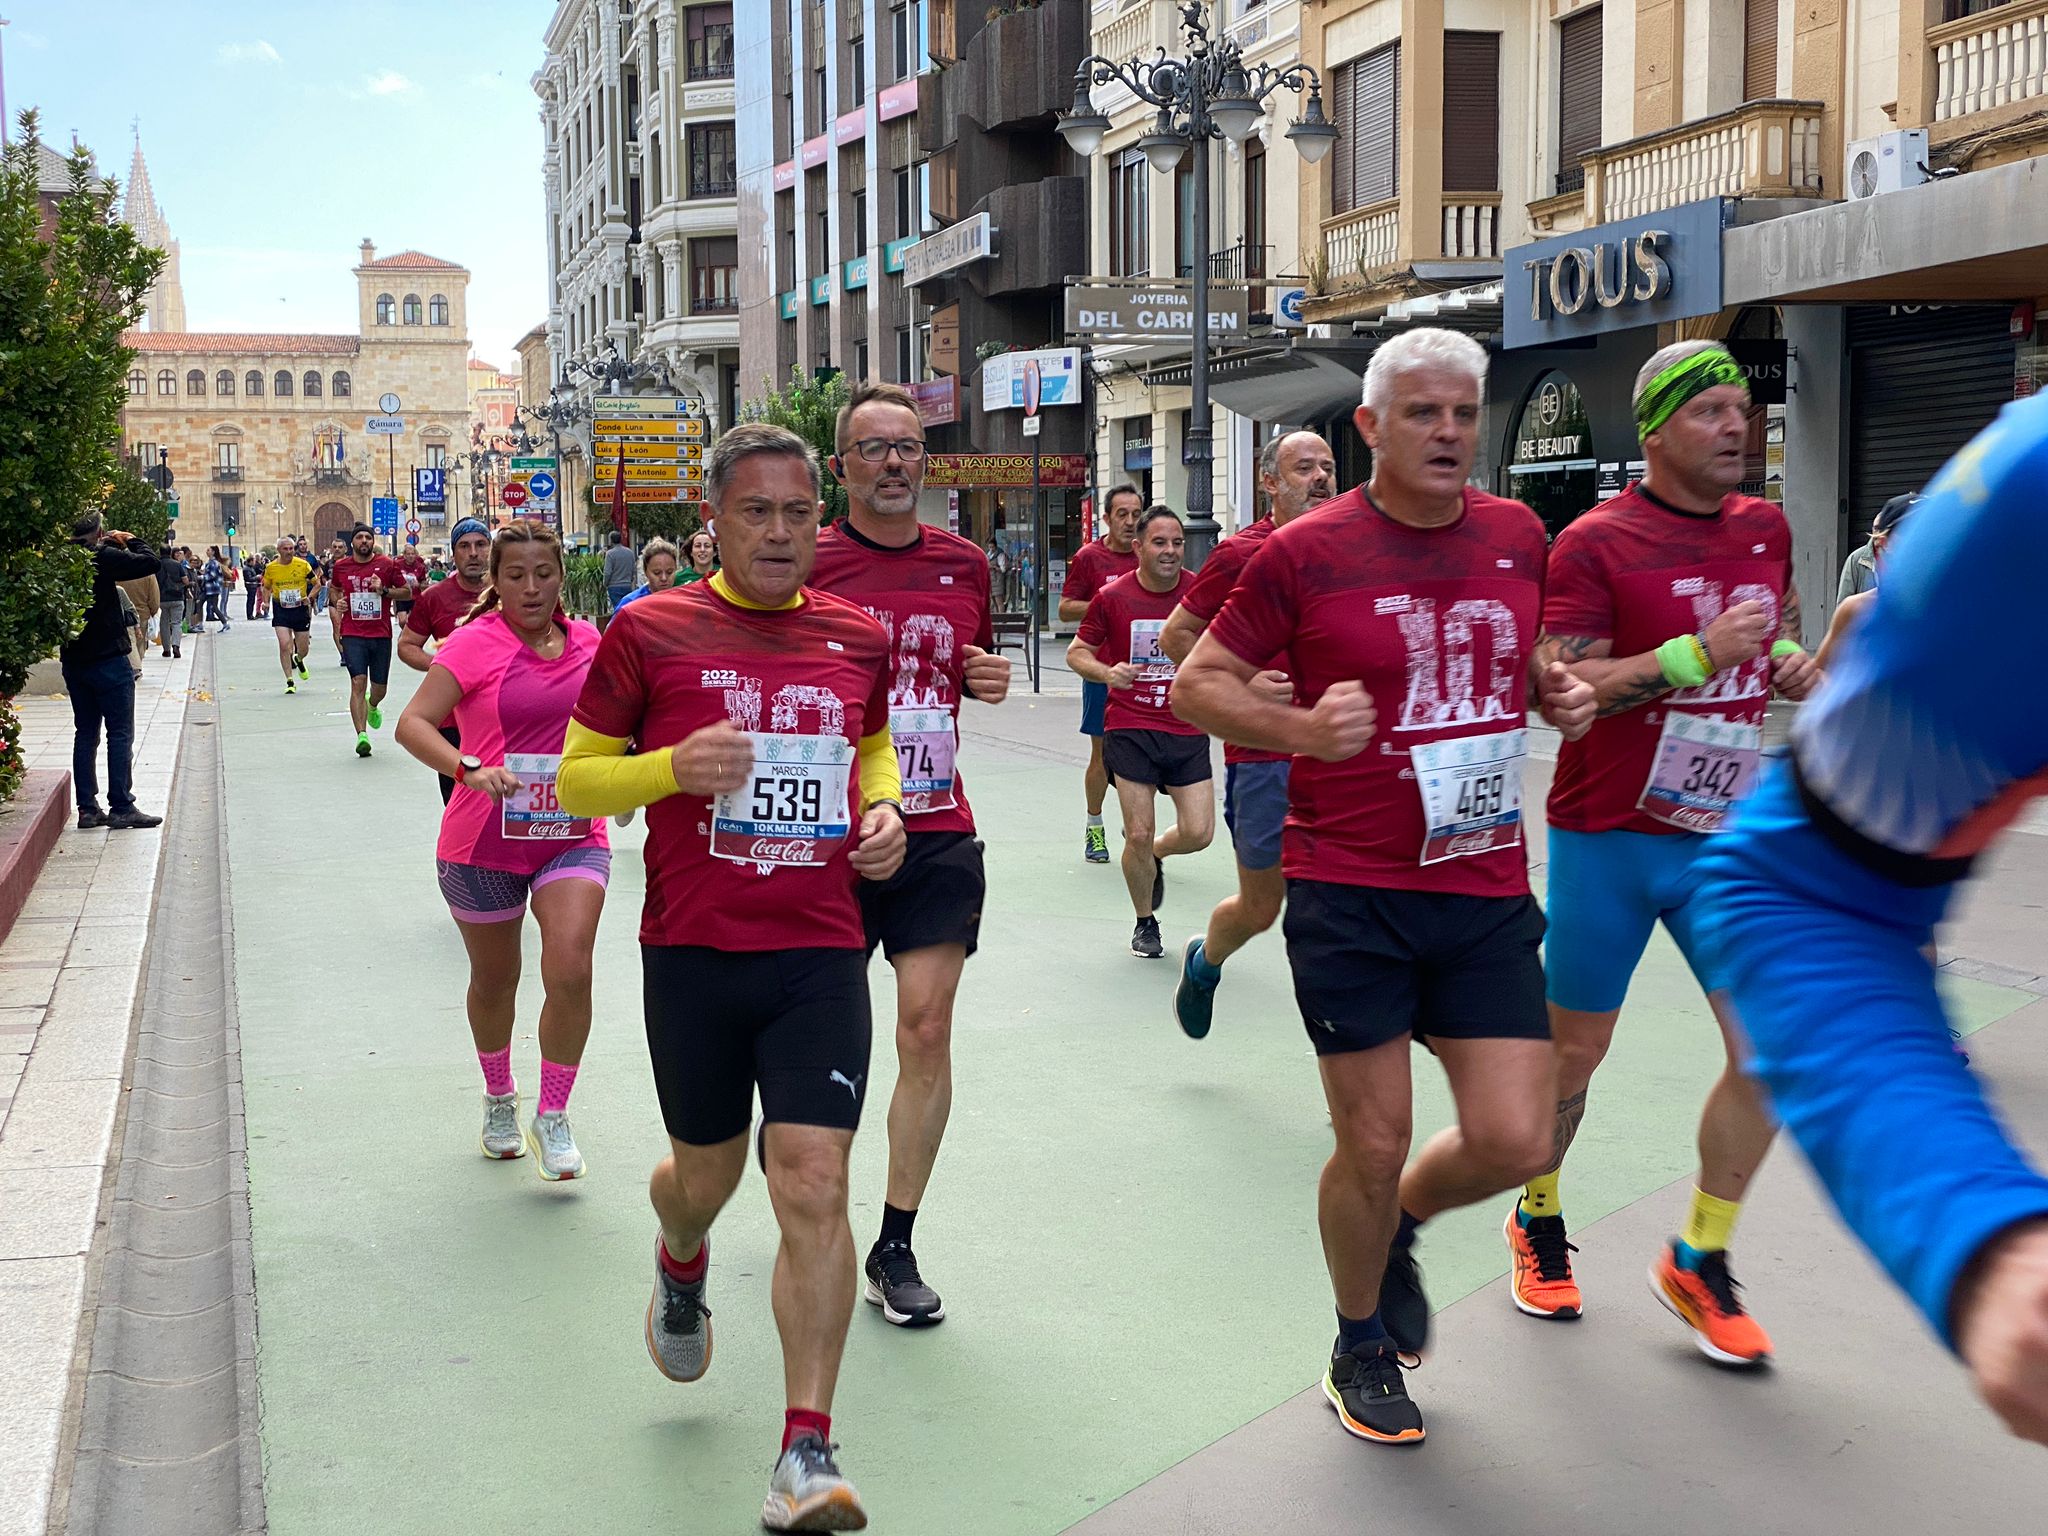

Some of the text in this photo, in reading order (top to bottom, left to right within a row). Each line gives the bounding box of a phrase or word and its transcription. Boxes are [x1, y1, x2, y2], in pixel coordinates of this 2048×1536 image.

[1523, 230, 1672, 321] TOUS
[1129, 294, 1188, 305] JOYERIA
[1079, 310, 1124, 329] DEL
[1740, 363, 1782, 380] OUS
[1542, 394, 1557, 414] BE
[368, 419, 402, 430] Cámara
[596, 423, 621, 431] Conde
[629, 446, 648, 454] León
[1521, 435, 1580, 459] BE BEAUTY
[928, 456, 1061, 468] AL TANDOORI
[636, 468, 667, 476] Antonio
[285, 594, 296, 602] 466
[358, 601, 374, 611] 458
[701, 669, 737, 681] 2022
[893, 734, 922, 743] BLANCA
[894, 744, 935, 778] 74
[771, 765, 809, 777] MARCOS
[1683, 754, 1740, 798] 342
[902, 780, 931, 788] MLEON
[529, 783, 565, 812] 36
[752, 777, 821, 822] 539
[1457, 773, 1503, 819] 469
[528, 822, 572, 836] Coca-Cola
[753, 823, 815, 834] 10KMLEON
[750, 838, 817, 862] Coca-Cola
